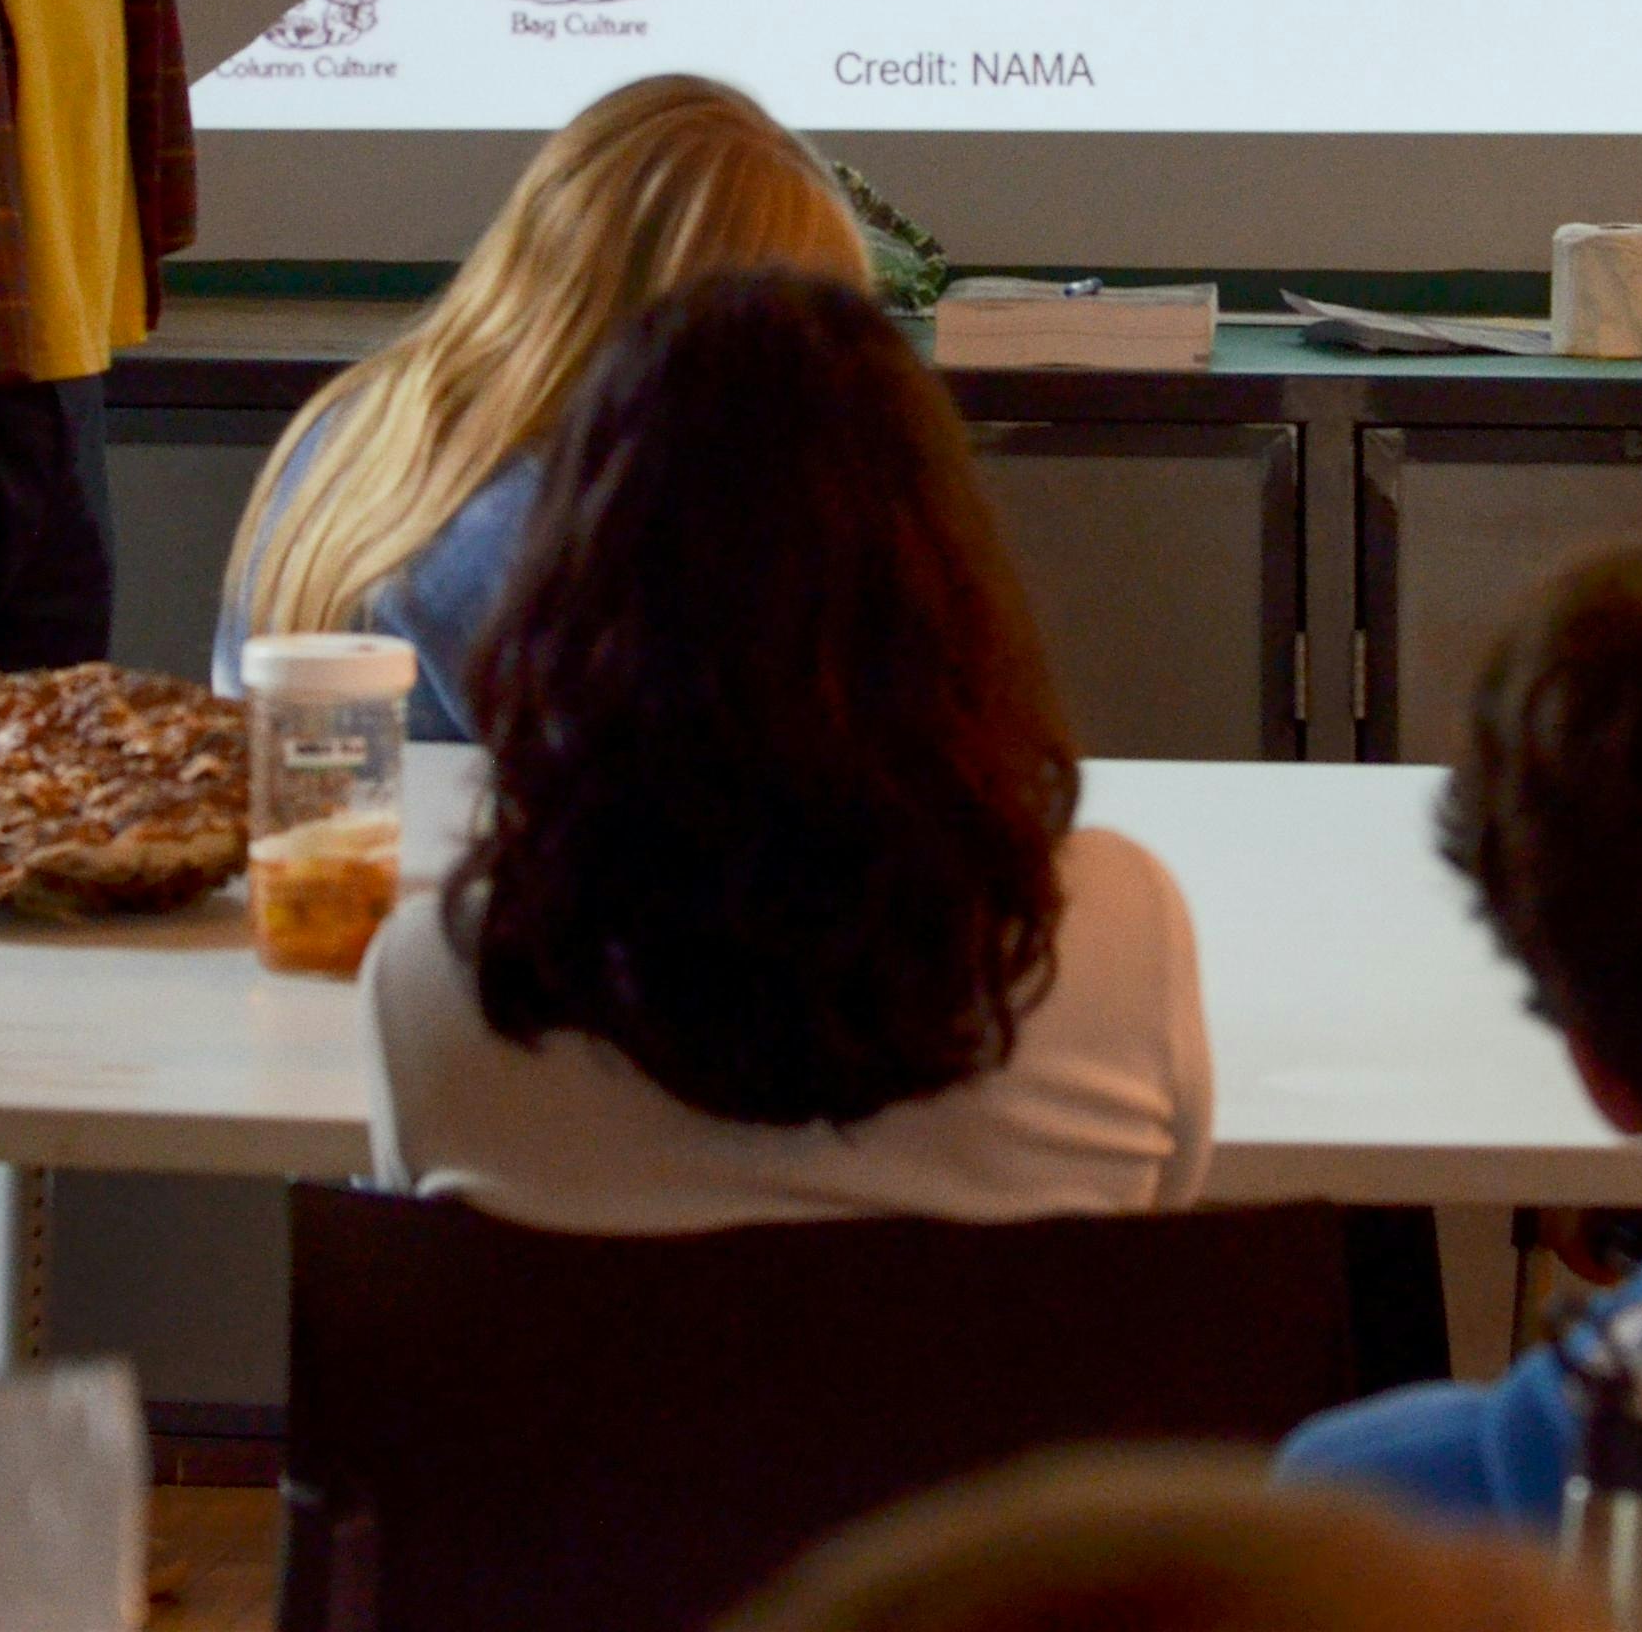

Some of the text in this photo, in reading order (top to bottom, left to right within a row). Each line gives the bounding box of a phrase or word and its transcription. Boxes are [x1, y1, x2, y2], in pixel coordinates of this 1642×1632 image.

[512, 13, 647, 38] Bag Culture
[216, 56, 397, 77] Column Culture
[834, 51, 1094, 86] Credit: NAMA
